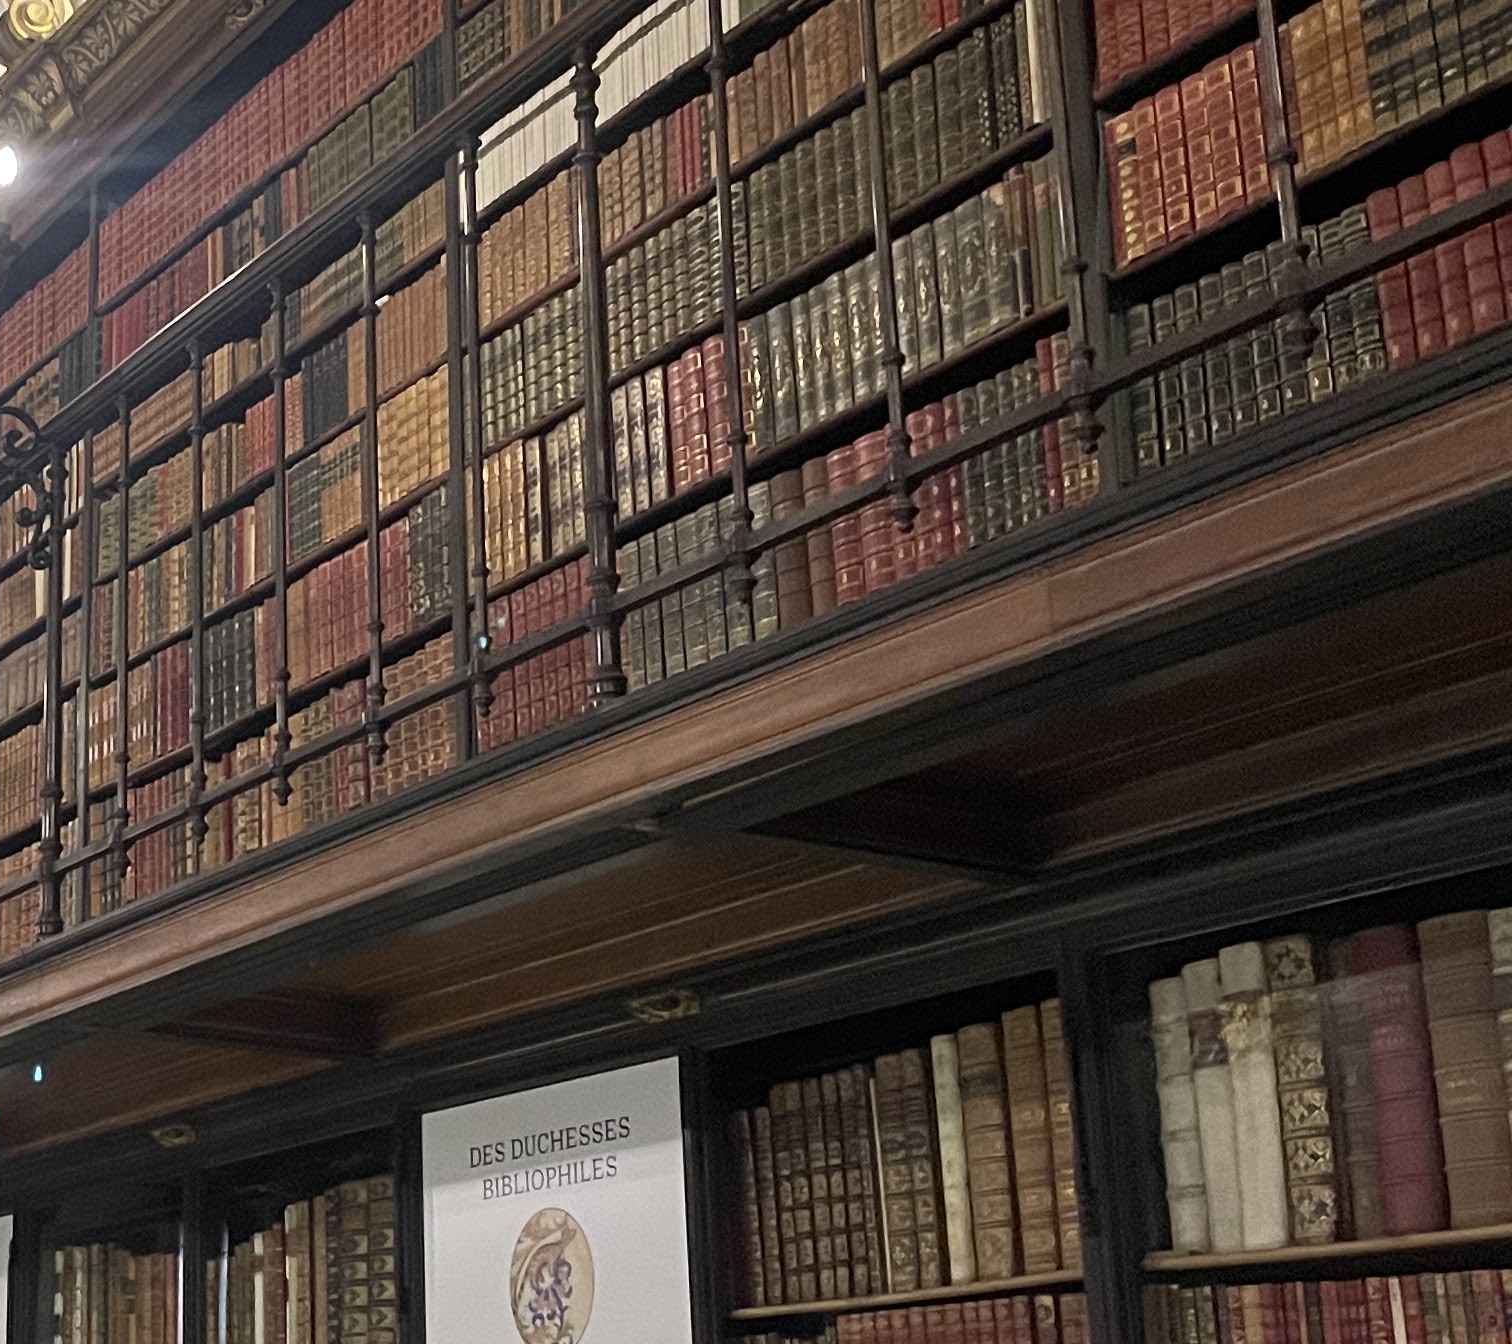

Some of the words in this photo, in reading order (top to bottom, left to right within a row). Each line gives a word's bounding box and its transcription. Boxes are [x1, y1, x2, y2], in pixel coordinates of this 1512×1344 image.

[469, 1142, 505, 1169] DES
[510, 1116, 631, 1162] DUCHESSES
[482, 1154, 618, 1200] BIBLIOPHILES
